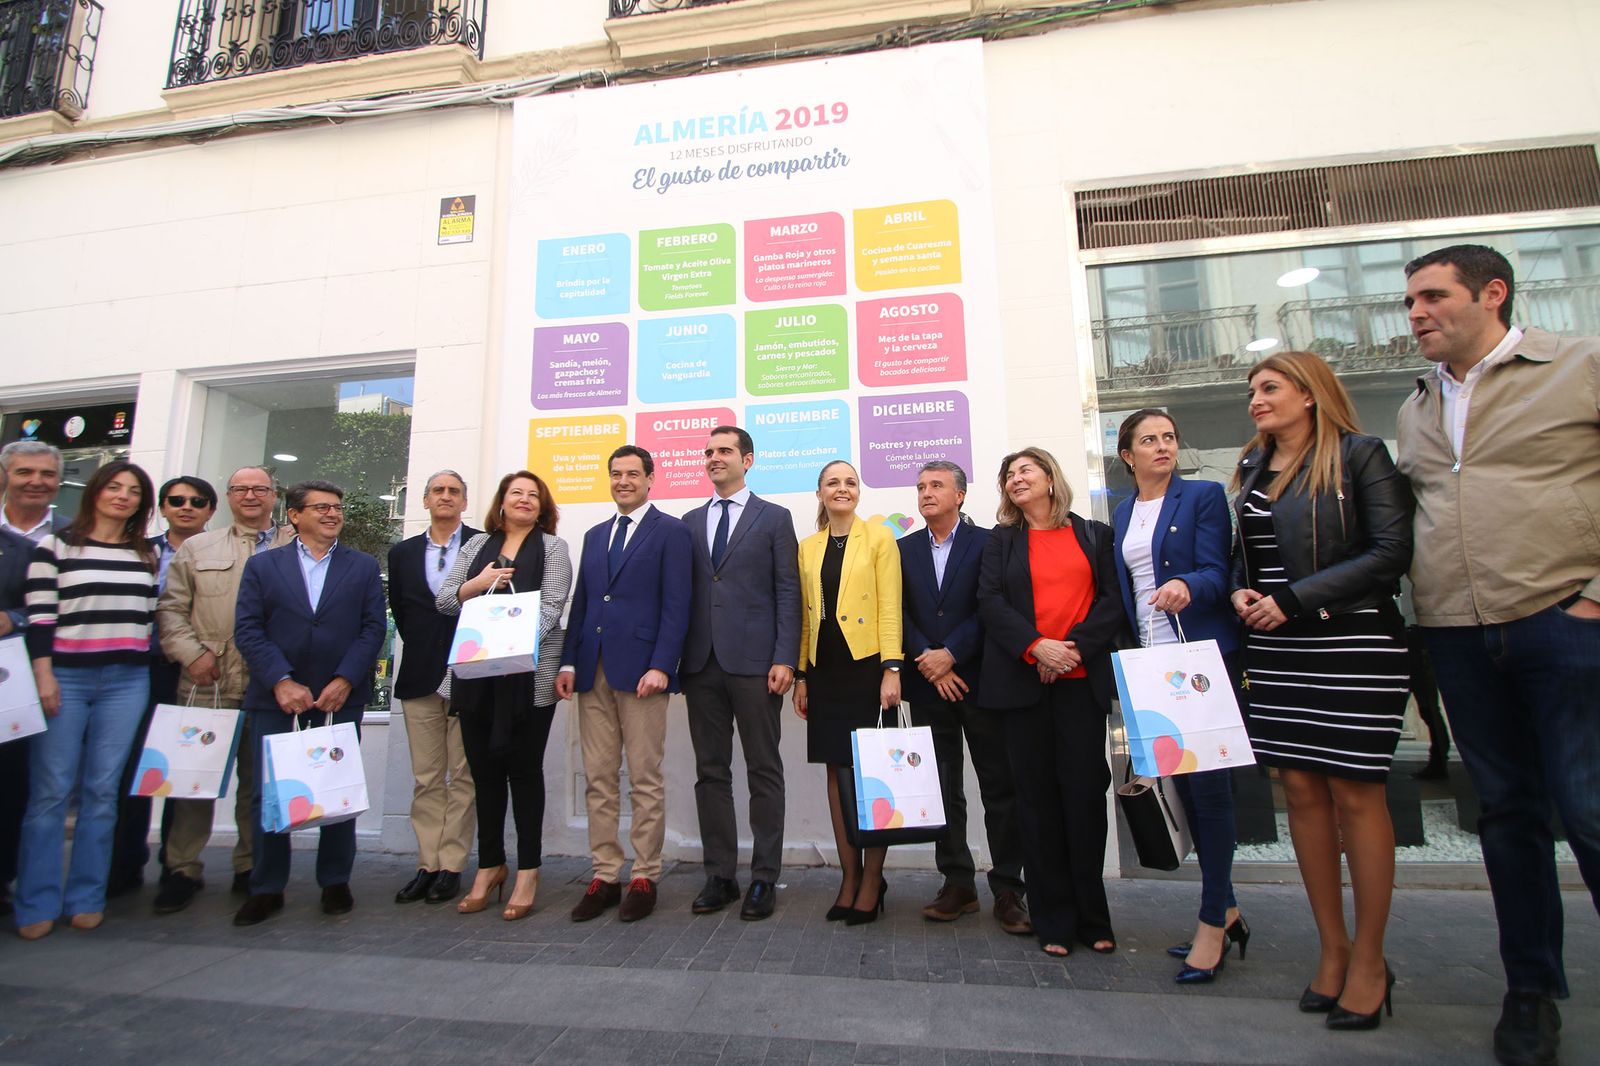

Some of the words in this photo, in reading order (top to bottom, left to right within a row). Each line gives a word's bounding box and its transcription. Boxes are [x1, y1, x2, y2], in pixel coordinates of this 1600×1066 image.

[634, 105, 768, 146] ALMERÍA
[775, 102, 848, 130] 2019
[670, 151, 682, 161] 12
[685, 146, 725, 159] MESES
[727, 136, 812, 156] DISFRUTANDO
[632, 167, 656, 190] El
[657, 165, 714, 194] gusto
[718, 160, 743, 181] de
[746, 148, 850, 180] compartir
[884, 210, 926, 225] ABRIL
[770, 222, 818, 237] MARZO
[657, 233, 718, 248] FEBRERO
[562, 242, 606, 257] ENERO
[862, 247, 891, 256] Cocina
[893, 243, 905, 252] de
[907, 240, 952, 250] Cuaresma
[753, 253, 783, 263] Gamba
[785, 250, 804, 261] Roja
[806, 250, 812, 259] y
[813, 248, 837, 257] otros
[872, 258, 878, 267] y
[880, 255, 915, 264] semana
[917, 251, 942, 260] santa
[643, 263, 673, 272] Tomate
[675, 263, 681, 271] y
[682, 259, 707, 269] Aceite
[709, 257, 732, 266] Oliva
[758, 263, 785, 272] platos
[786, 258, 832, 269] marineros
[661, 272, 688, 282] Virgen
[690, 270, 712, 279] Extra
[555, 279, 584, 288] Brindis
[560, 288, 605, 299] capitalidad
[880, 303, 939, 318] AGOSTO
[775, 315, 817, 329] JULIO
[666, 323, 708, 337] JUNIO
[898, 334, 910, 342] de
[911, 332, 920, 341] la
[922, 331, 943, 341] tapa
[563, 332, 600, 345] MAYO
[753, 341, 787, 352] Jamón,
[788, 338, 839, 350] embutidos,
[757, 352, 786, 361] carnes
[788, 352, 794, 361] y
[795, 348, 836, 359] pescados
[884, 346, 890, 354] y
[892, 344, 900, 352] la
[902, 342, 938, 352] cerveza
[549, 359, 581, 369] Sandía,
[582, 357, 611, 368] melón,
[666, 361, 694, 369] Cocina
[695, 360, 706, 368] de
[775, 364, 796, 372] Sierra
[874, 360, 882, 368] El
[882, 359, 902, 369] gusto
[903, 358, 913, 366] de
[914, 355, 950, 366] compartir
[555, 368, 599, 380] gazpachos
[600, 368, 606, 378] y
[662, 369, 711, 382] Vanguardia
[880, 368, 909, 377] bocados
[911, 365, 946, 375] deliciosos
[554, 379, 585, 387] cremas
[586, 376, 606, 385] frías
[563, 390, 586, 399] frescos
[587, 389, 597, 397] de
[597, 388, 621, 397] Almería
[873, 400, 954, 417] DICIEMBRE
[755, 408, 840, 425] NOVIEMBRE
[536, 423, 621, 438] SEPTIEMBRE
[653, 417, 718, 432] OCTUBRE
[869, 441, 904, 450] Postres
[905, 441, 912, 450] y
[913, 435, 962, 448] repostería
[570, 455, 576, 464] y
[577, 453, 600, 461] vinos
[660, 449, 671, 458] de
[672, 448, 685, 457] las
[759, 450, 786, 459] Platos
[788, 448, 800, 457] de
[801, 446, 838, 456] cuchara
[885, 453, 913, 462] Cómete
[914, 452, 922, 460] la
[553, 463, 564, 472] de
[566, 463, 574, 471] la
[576, 462, 599, 471] tierra
[662, 459, 672, 468] de
[889, 462, 911, 470] mejor
[665, 471, 673, 479] El
[673, 469, 693, 480] abrigo
[695, 469, 704, 477] de
[670, 478, 700, 488] poniente
